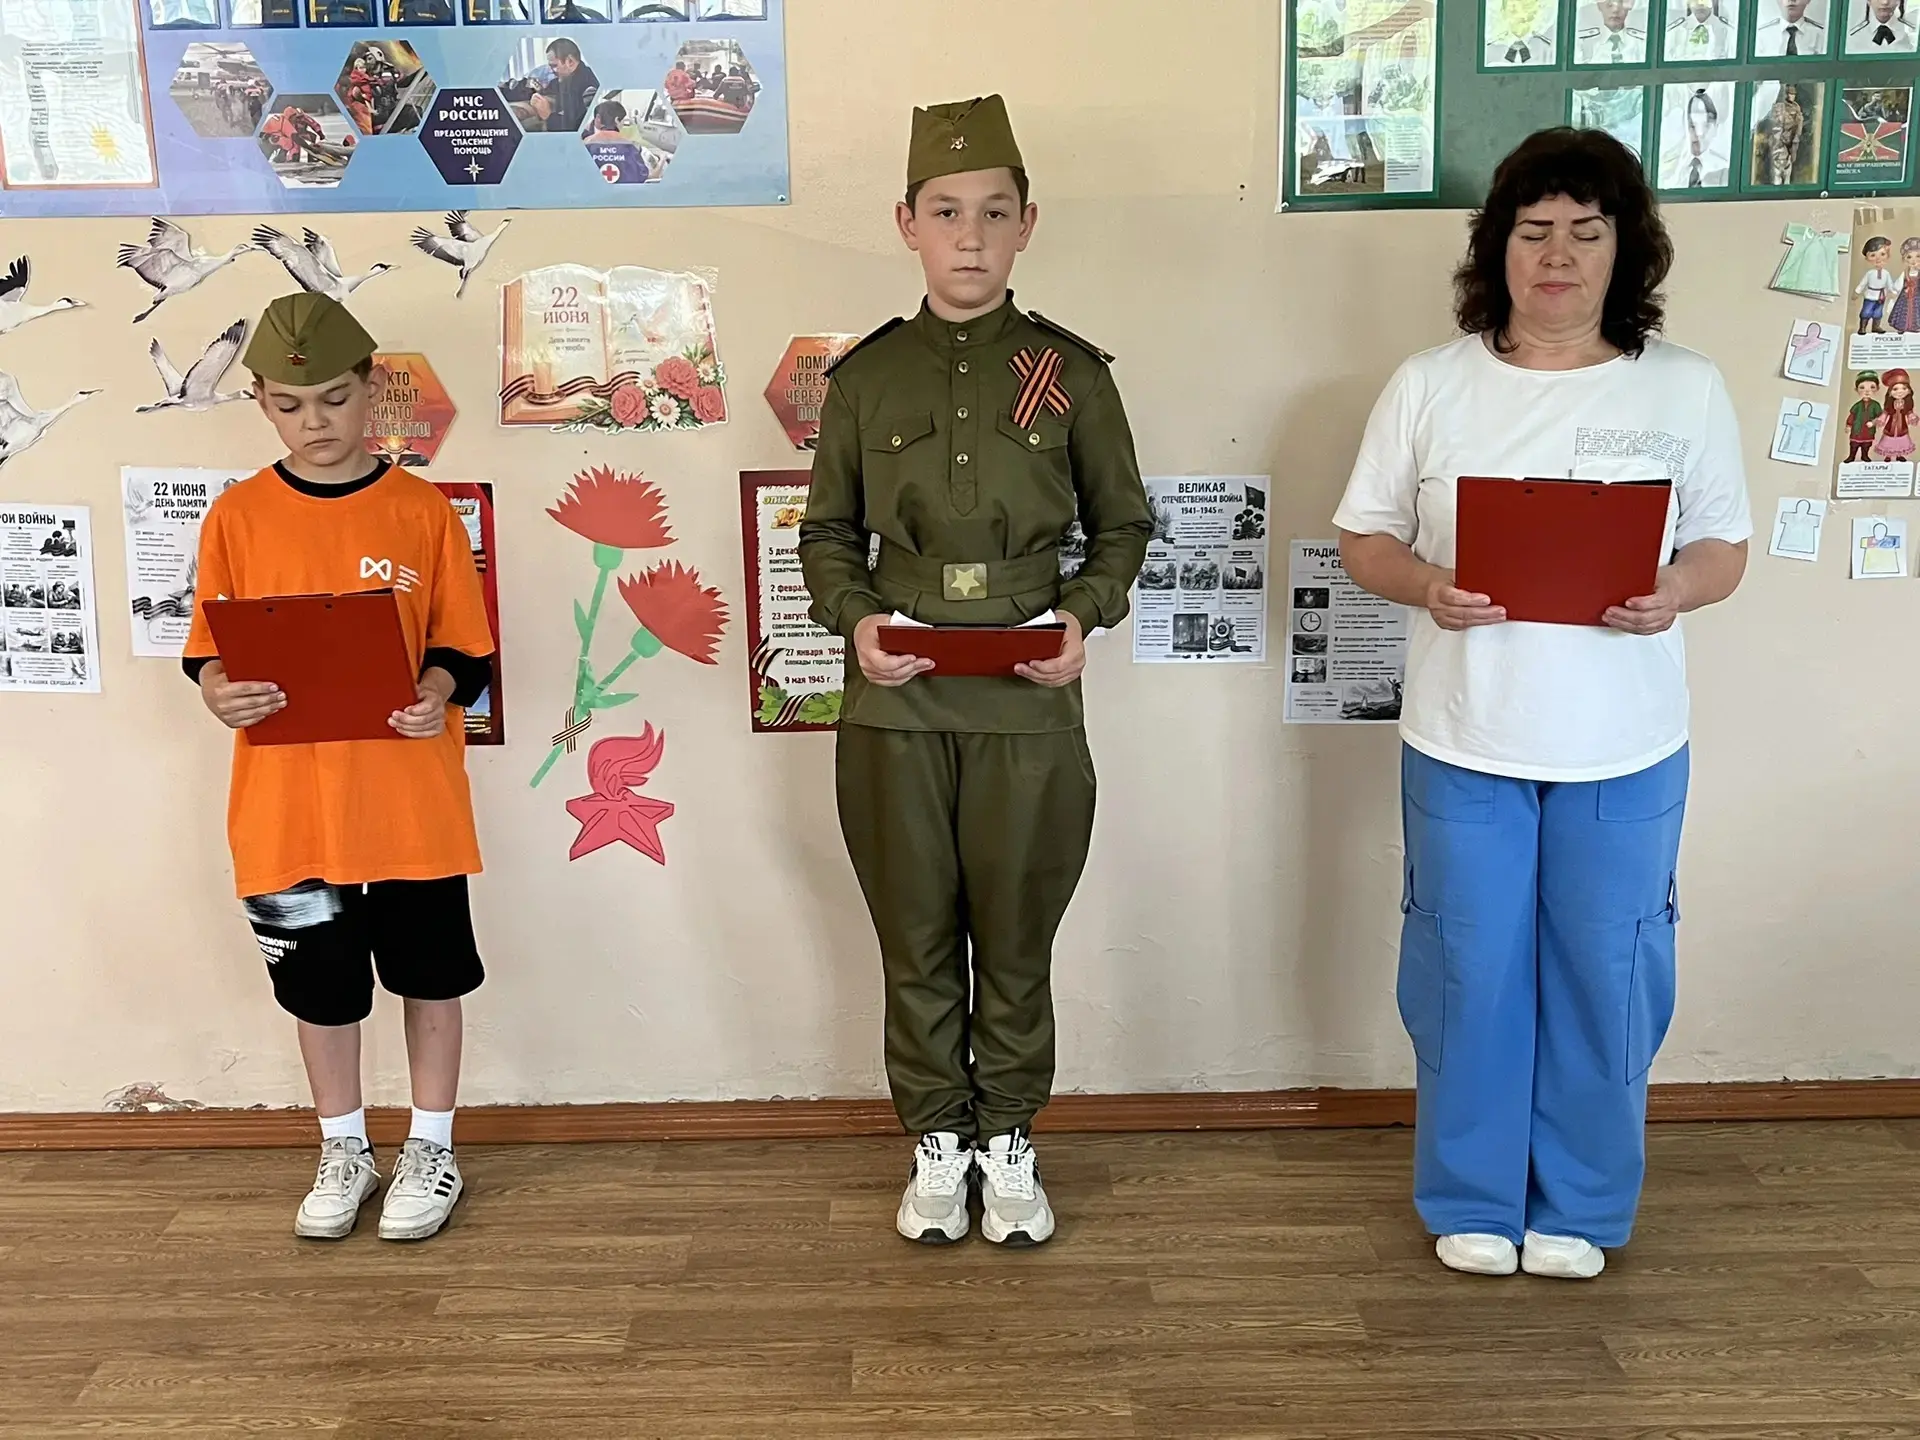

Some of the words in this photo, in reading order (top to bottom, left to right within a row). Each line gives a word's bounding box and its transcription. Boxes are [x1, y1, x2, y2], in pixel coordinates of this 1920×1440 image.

[453, 96, 483, 107] МЧС
[439, 109, 499, 121] РОССИИ
[434, 128, 509, 138] ПРЕДОТВРАЩЕНИЕ
[451, 138, 493, 146] СПАСЕНИЕ
[453, 147, 492, 155] ПОМОЩЬ
[592, 154, 625, 162] РОССИИ
[551, 286, 579, 308] 22
[543, 310, 590, 324] ИЮНЯ
[387, 371, 410, 386] КТО
[789, 372, 827, 386] ЧЕРЕЗ
[785, 389, 823, 403] ЧЕРЕЗ
[372, 405, 412, 419] НИЧТО
[375, 422, 430, 437] ЗАБЫТО!
[153, 482, 169, 496] 22
[172, 483, 206, 497] ИЮНЯ
[1178, 482, 1226, 494] ВЕЛИКАЯ
[155, 498, 175, 508] ДЕНЬ
[177, 499, 208, 508] ПАМЯТИ
[1161, 494, 1218, 504] ОТЕЧЕСТВЕННАЯ
[1219, 493, 1243, 503] ВОЙНА
[18, 511, 56, 525] ВОЙНЫ
[163, 510, 169, 519] И
[171, 510, 201, 520] СКОРБИ
[768, 547, 774, 555] 5
[775, 547, 799, 556] декаб
[770, 584, 776, 592] 2
[777, 584, 808, 594] феврал
[771, 612, 781, 620] 23
[785, 648, 794, 656] 27
[796, 649, 823, 658] января
[784, 676, 790, 684] 9
[808, 675, 825, 684] 1945
